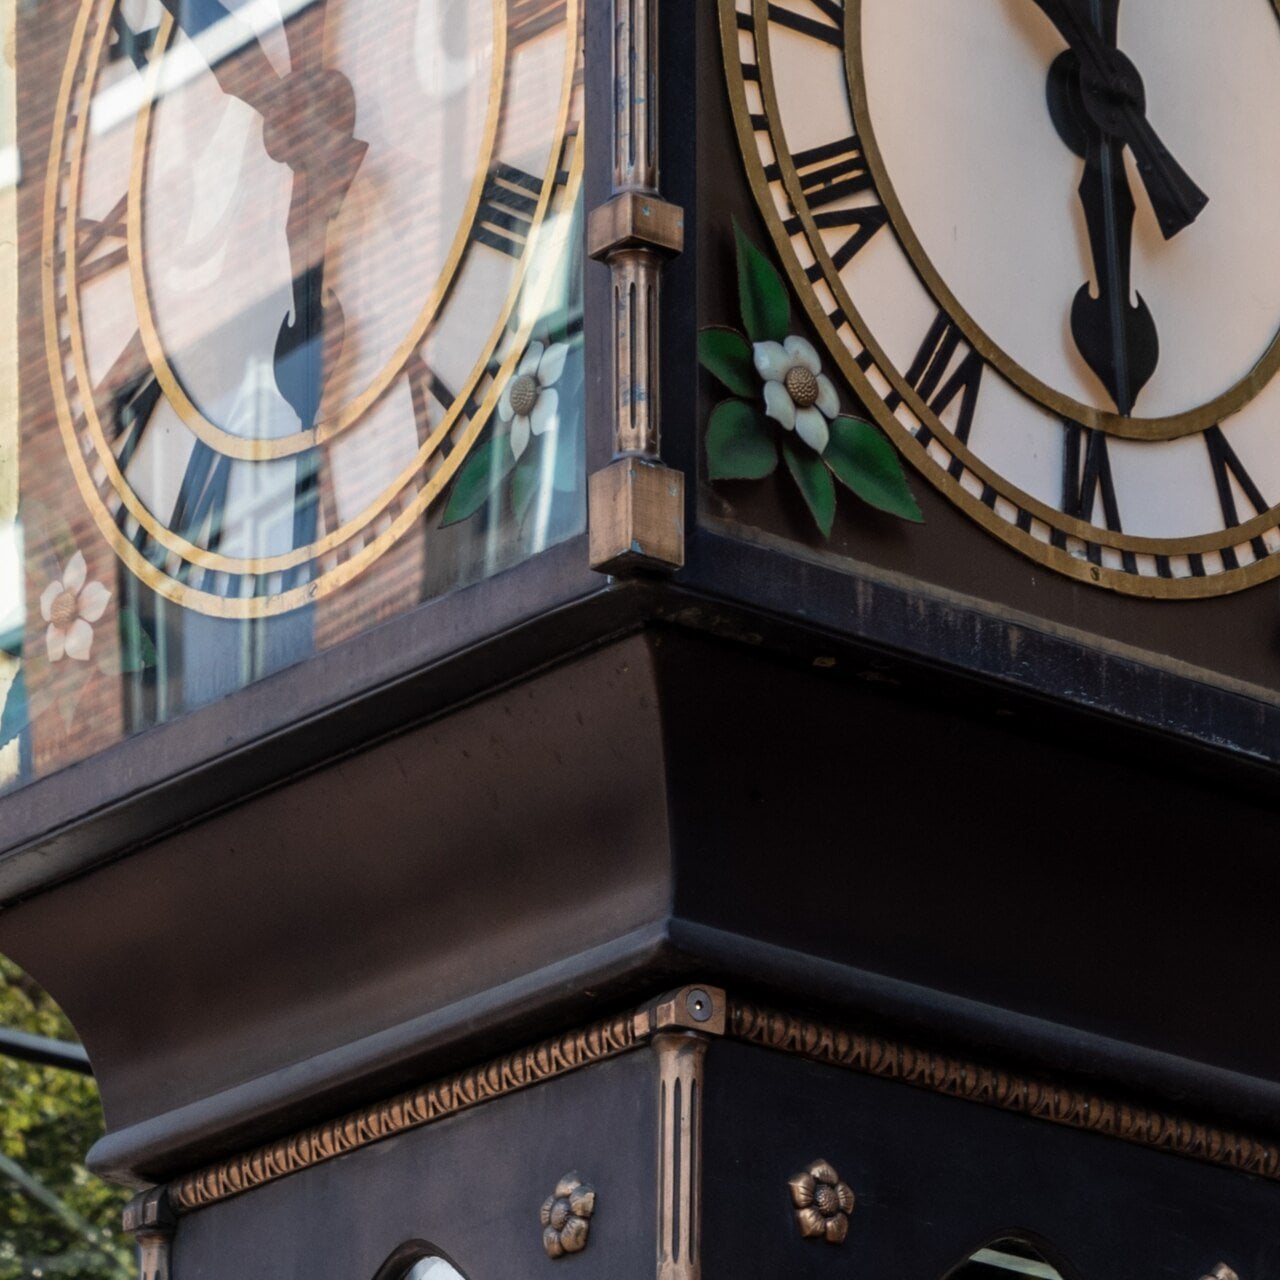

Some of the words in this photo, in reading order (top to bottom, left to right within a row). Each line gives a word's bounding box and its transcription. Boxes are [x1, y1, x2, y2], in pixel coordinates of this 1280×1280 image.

[79, 190, 130, 284] IX
[470, 161, 545, 260] IIII
[790, 135, 888, 273] VIII
[904, 308, 984, 446] VII
[1063, 419, 1122, 534] VI
[1203, 425, 1269, 530] V
